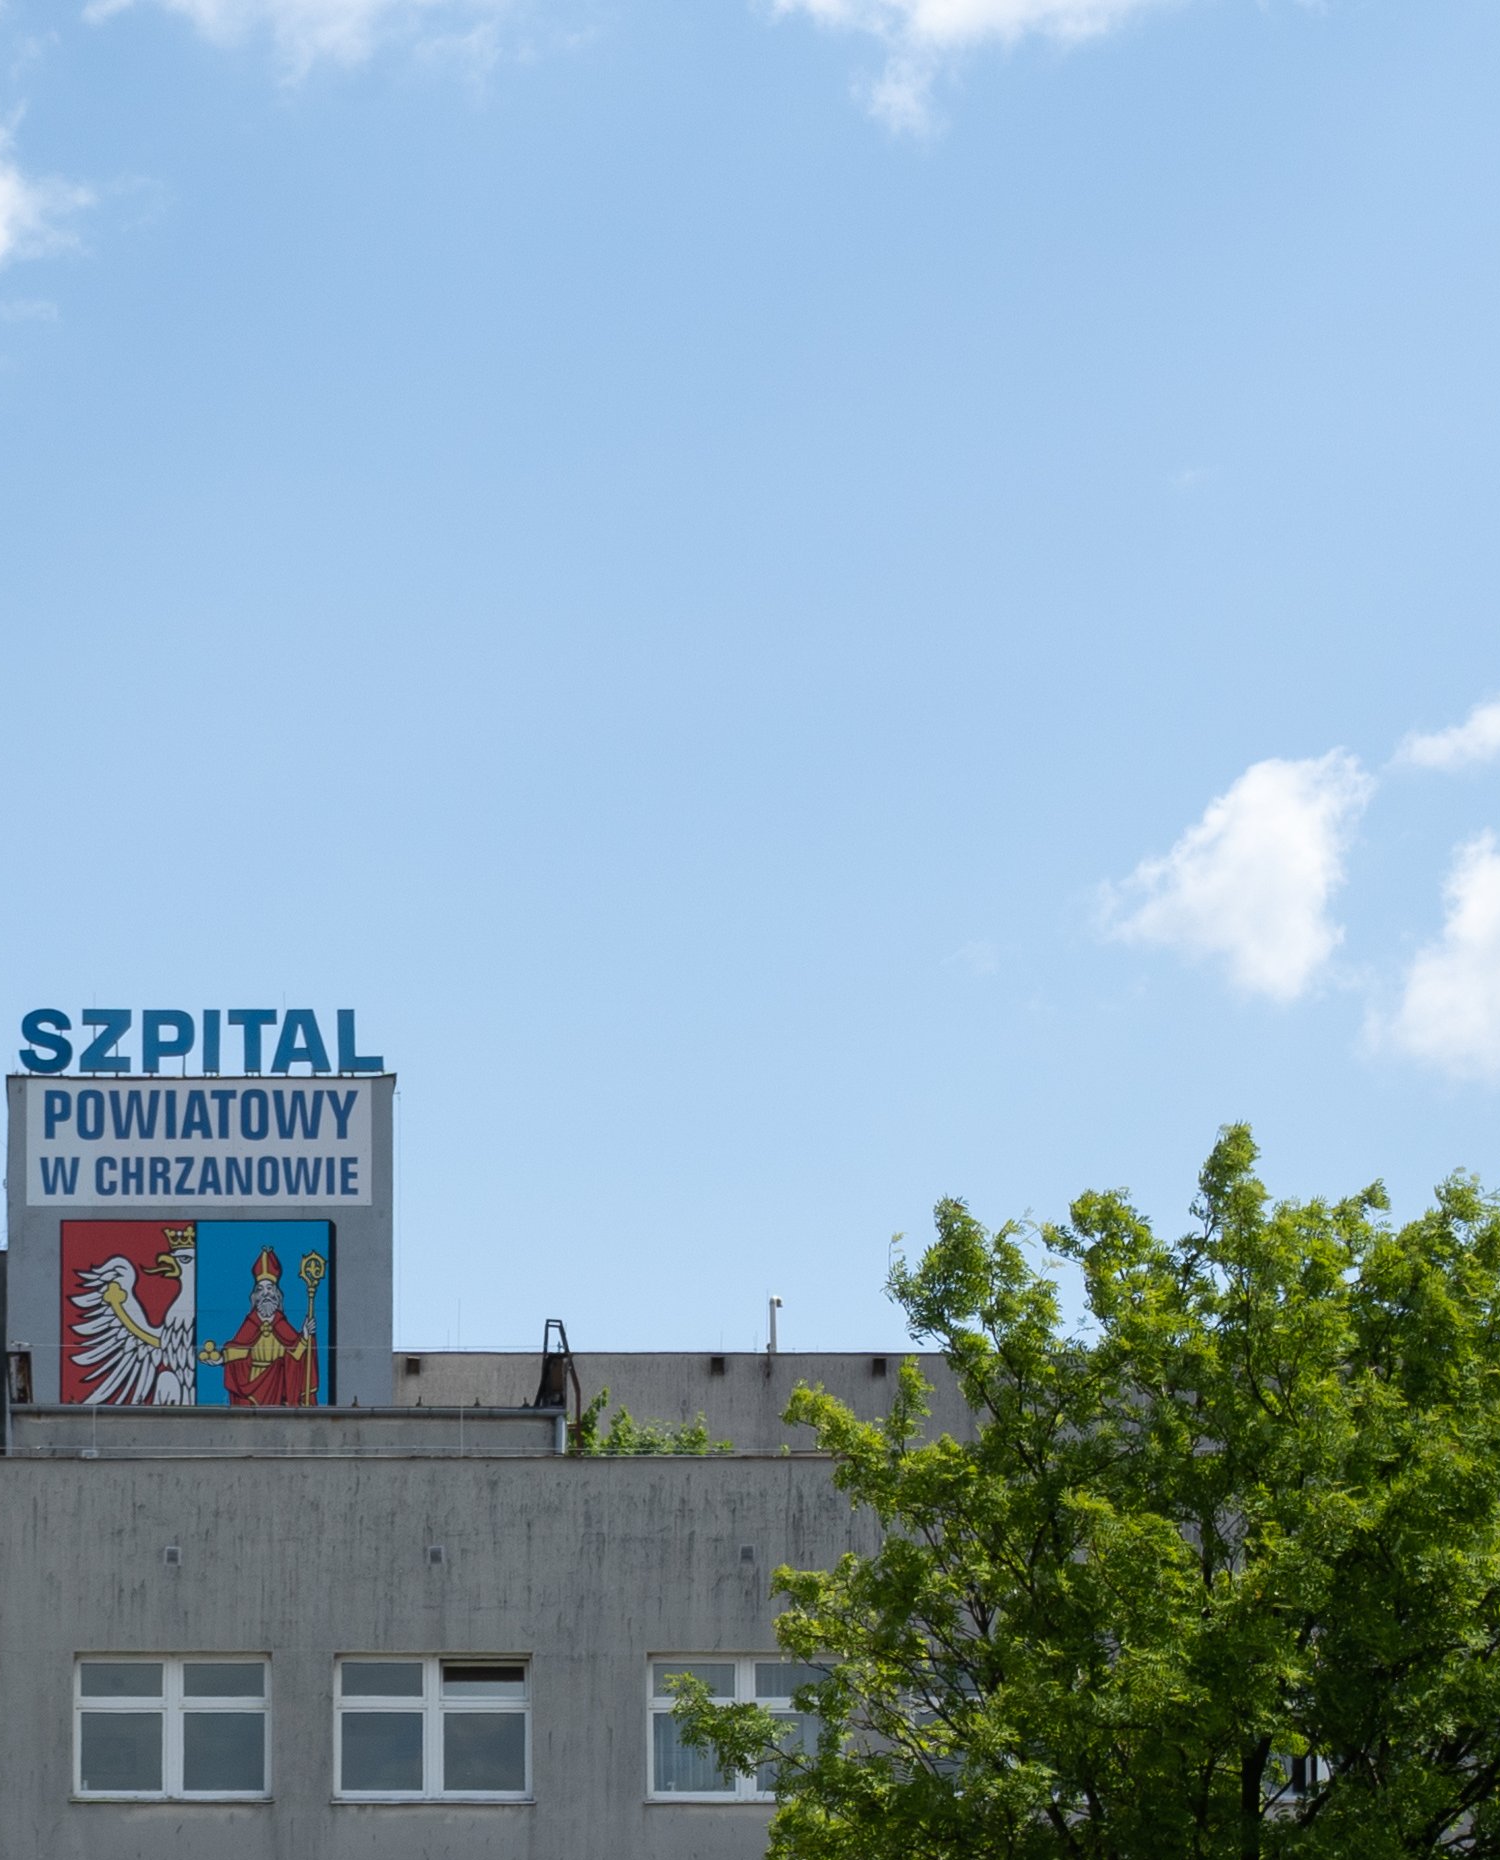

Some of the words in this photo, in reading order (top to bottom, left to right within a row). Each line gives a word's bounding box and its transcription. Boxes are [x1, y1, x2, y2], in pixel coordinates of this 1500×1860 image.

[19, 1008, 384, 1073] SZPITAL
[43, 1088, 358, 1141] POWIATOWY
[40, 1156, 80, 1196] W
[95, 1155, 359, 1197] CHRZANOWIE
